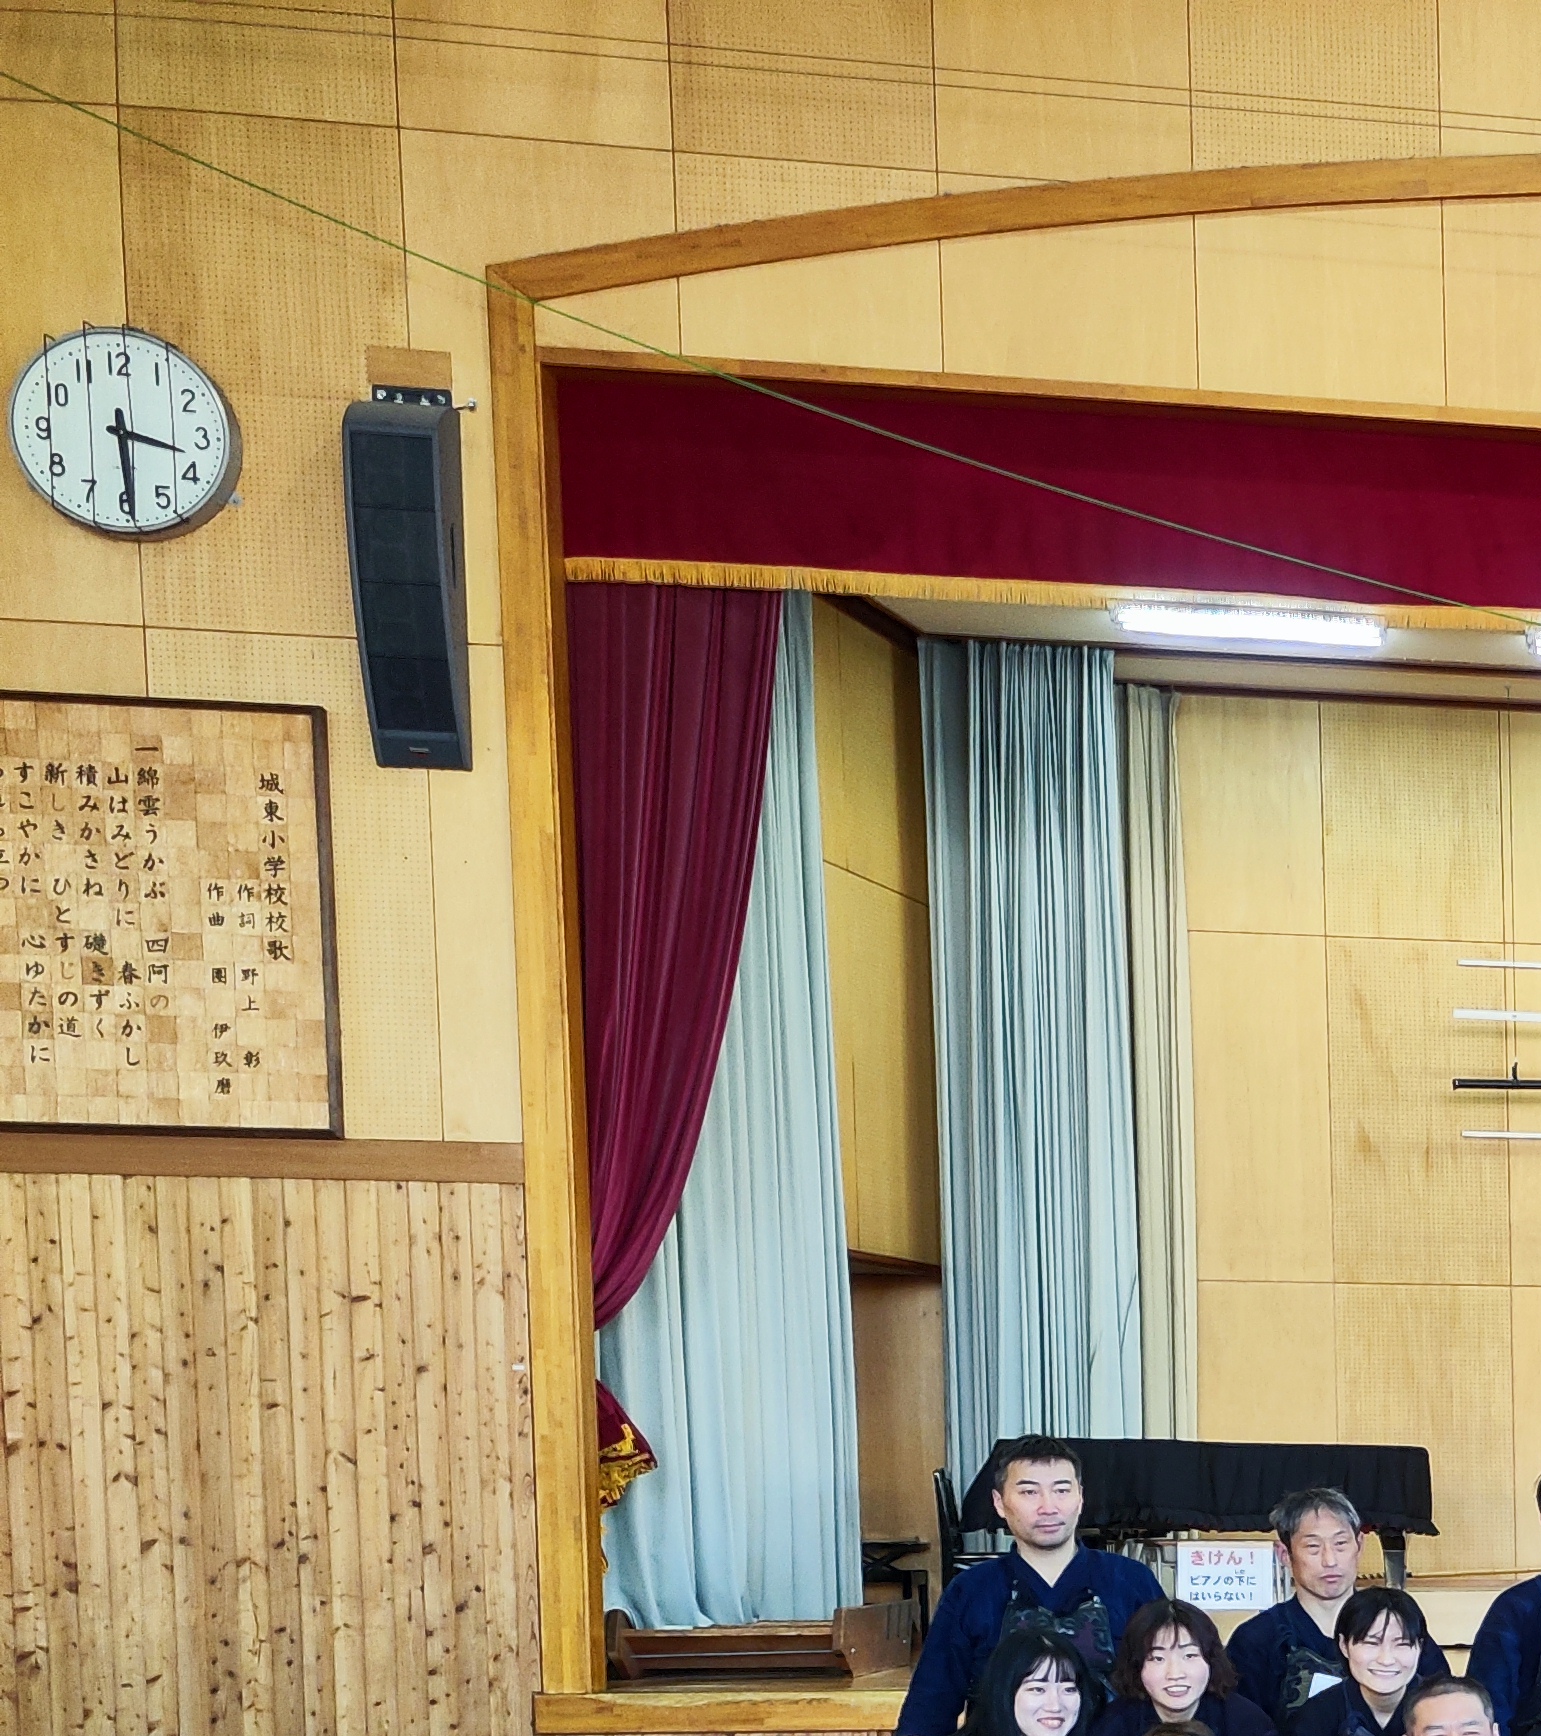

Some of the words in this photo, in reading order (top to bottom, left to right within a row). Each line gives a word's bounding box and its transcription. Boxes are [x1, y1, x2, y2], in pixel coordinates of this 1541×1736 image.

[75, 357, 92, 384] 11
[107, 350, 131, 378] 12
[46, 382, 69, 407] 10
[181, 389, 197, 413] 2
[35, 416, 51, 440] 9
[194, 426, 211, 450] 3
[49, 454, 66, 477] 8
[181, 461, 201, 484] 4
[80, 479, 97, 504] 7
[118, 491, 135, 515] 6
[155, 486, 171, 510] 5
[44, 761, 69, 841] 新しき
[13, 761, 42, 894] すこやかに
[75, 763, 105, 898] 積みかさね
[106, 766, 136, 927] 山はみどりに
[258, 772, 291, 962] 城東小学校校歌
[207, 882, 225, 929] 作曲
[237, 882, 256, 931] 作詞
[52, 876, 82, 1038] ひとすじの道
[82, 933, 110, 1039] 礎きずく
[145, 936, 170, 1010] 四阿の
[211, 966, 227, 984] 團
[21, 933, 52, 1064] 心ゆたかに
[240, 967, 260, 1012] 野上
[117, 961, 142, 1067] 春ふかし
[243, 1050, 261, 1069] 彰
[1190, 1550, 1255, 1566] きけん！
[1190, 1575, 1257, 1587] ピアノの下に
[1189, 1591, 1254, 1602] はいらない！
